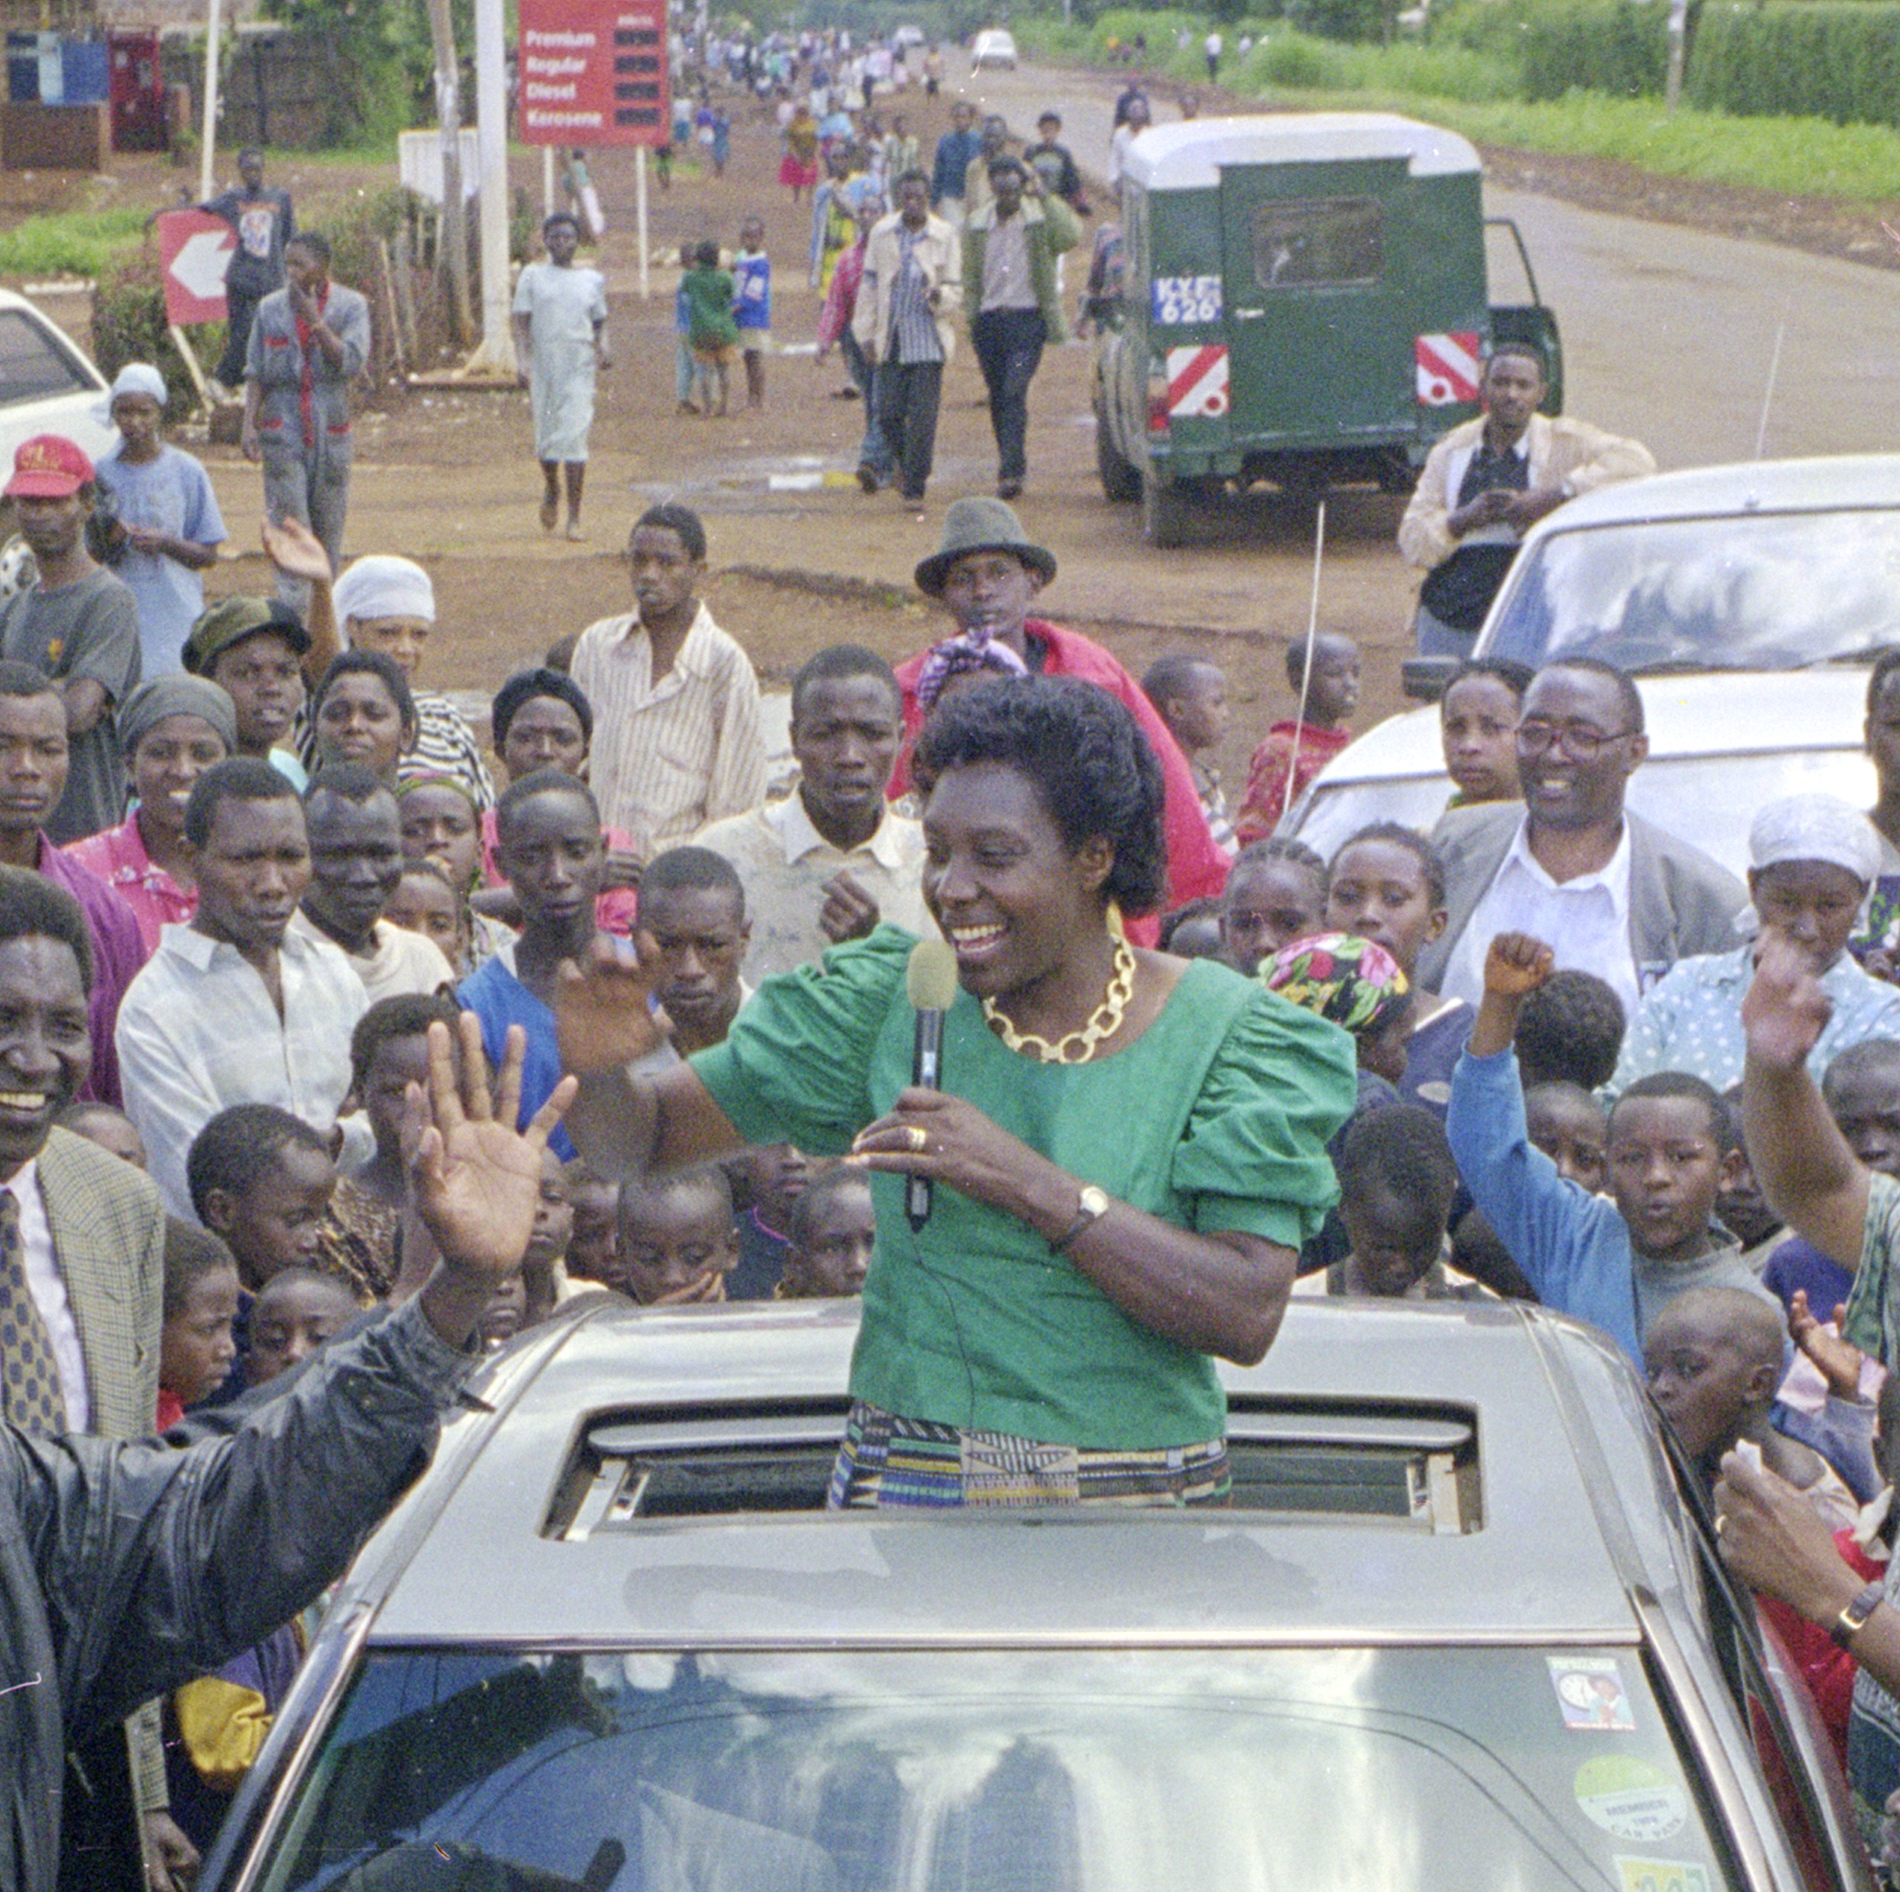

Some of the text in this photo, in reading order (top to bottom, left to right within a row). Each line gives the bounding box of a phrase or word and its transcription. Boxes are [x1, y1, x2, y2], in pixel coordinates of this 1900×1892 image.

[525, 29, 597, 48] Premium
[525, 56, 587, 77] Regular
[525, 81, 577, 101] Diesel
[525, 108, 604, 128] Kerosene
